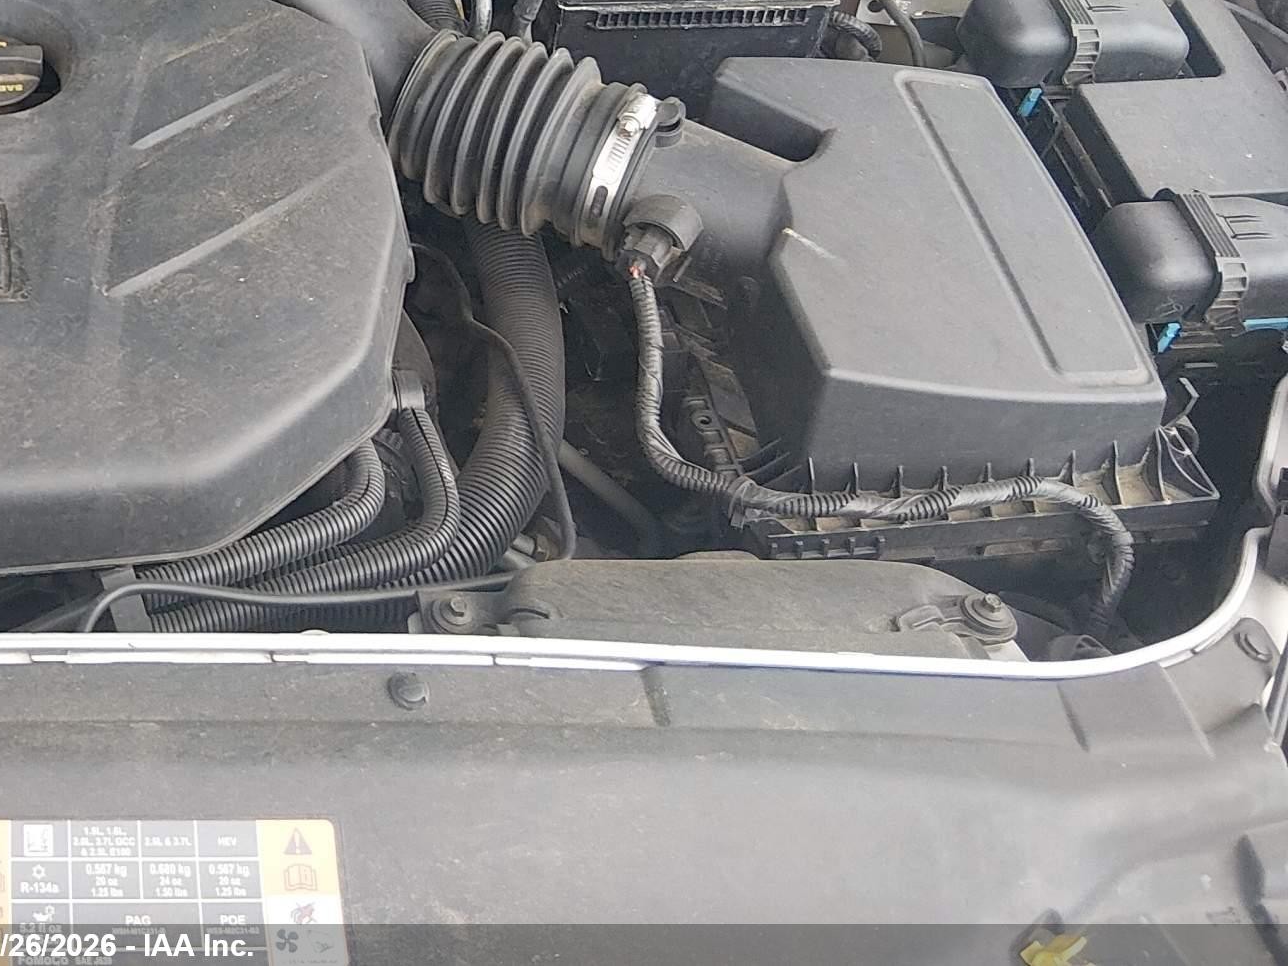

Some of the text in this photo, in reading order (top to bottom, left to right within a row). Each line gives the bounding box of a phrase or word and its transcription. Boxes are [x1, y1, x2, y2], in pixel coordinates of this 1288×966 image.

[217, 836, 237, 846] HEV
[114, 863, 128, 878] kg
[178, 863, 192, 878] kg
[236, 863, 250, 878] kg
[20, 881, 59, 894] R-134a
[125, 915, 152, 927] PAG
[220, 914, 246, 926] POE
[48, 924, 63, 933] oz
